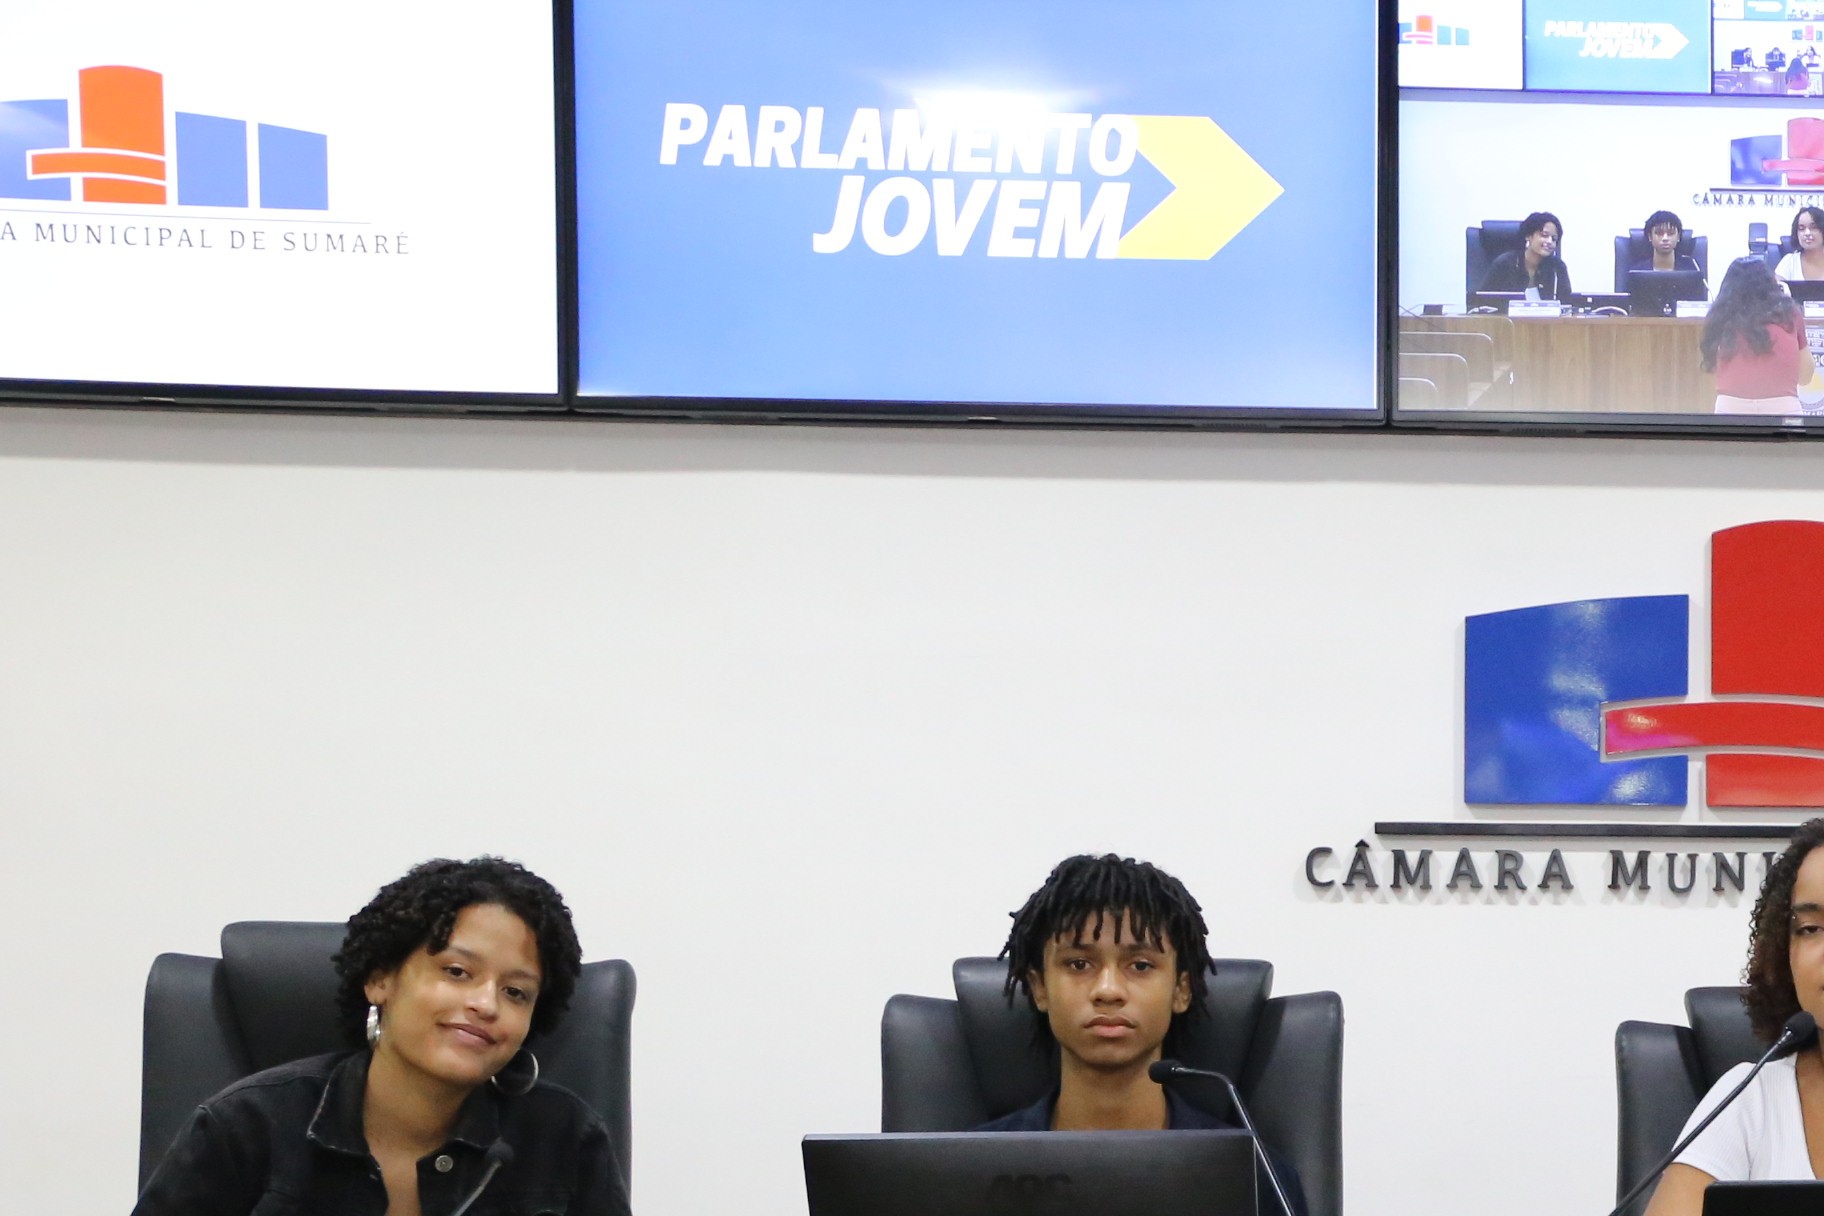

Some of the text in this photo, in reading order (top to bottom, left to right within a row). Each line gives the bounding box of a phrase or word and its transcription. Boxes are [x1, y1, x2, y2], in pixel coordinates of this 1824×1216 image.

[659, 102, 1139, 176] PARLAMENTO
[35, 222, 213, 249] MUNICIPAL
[230, 230, 266, 250] DE
[283, 231, 410, 255] SUMARÉ
[812, 175, 1131, 259] JOVEM
[1306, 838, 1576, 892] CÂMARA
